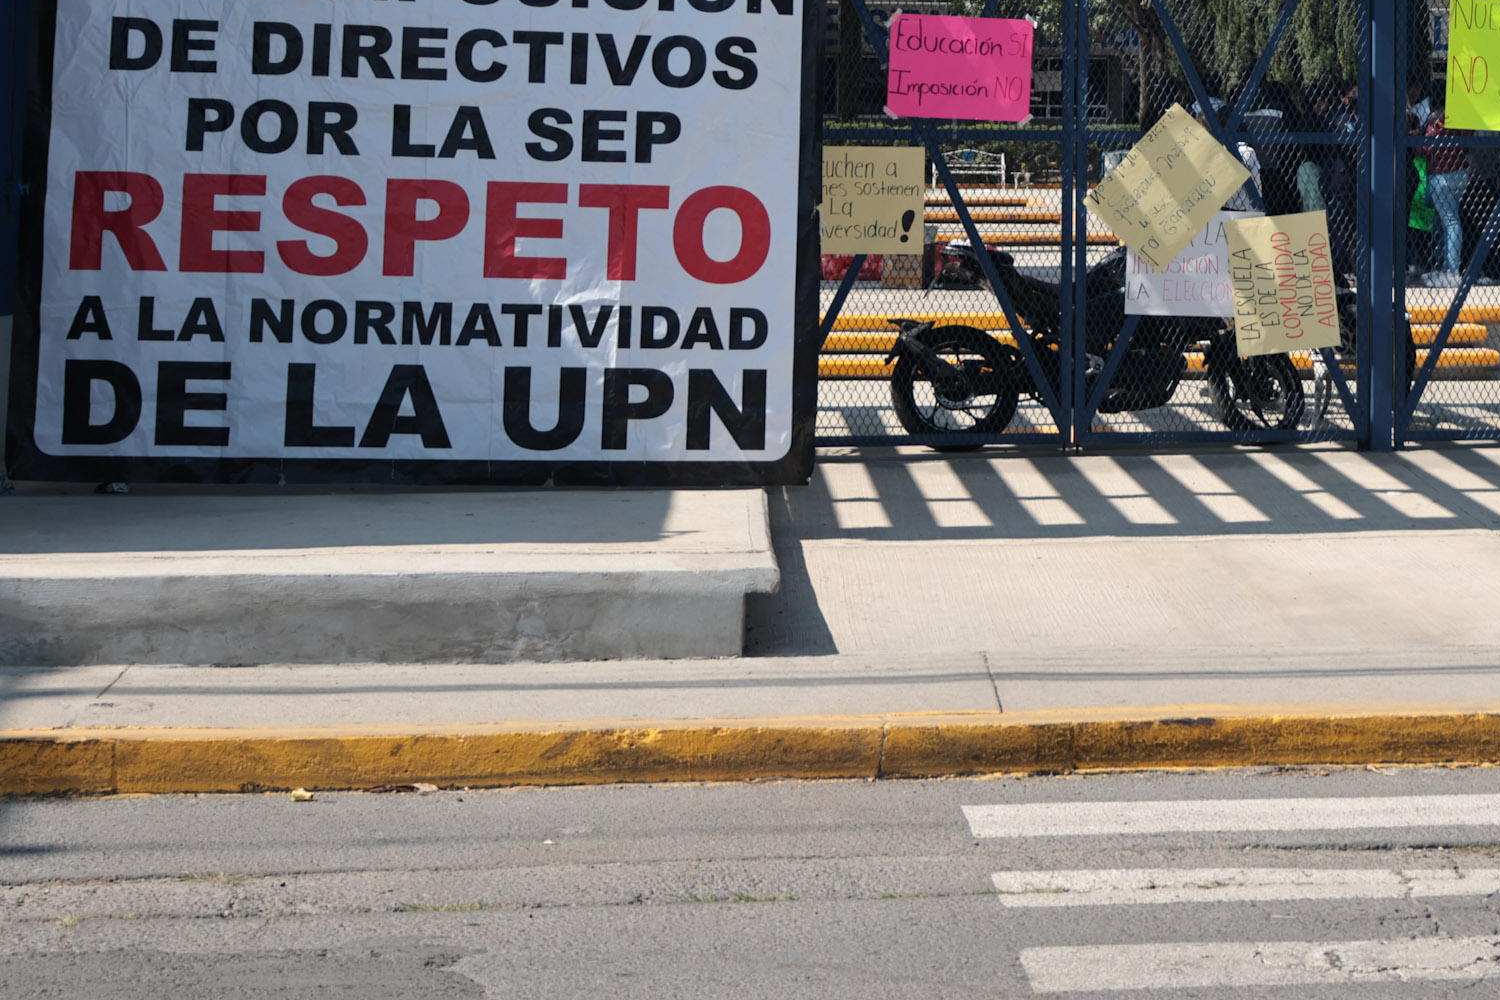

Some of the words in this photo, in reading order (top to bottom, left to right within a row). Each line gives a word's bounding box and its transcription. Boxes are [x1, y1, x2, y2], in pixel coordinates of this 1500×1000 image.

[895, 18, 1003, 57] Educación
[1008, 33, 1028, 59] SI
[109, 16, 219, 74] DE
[251, 20, 759, 91] DIRECTIVOS
[1451, 55, 1488, 95] NO
[889, 69, 988, 107] Imposición
[993, 77, 1023, 102] NO
[185, 97, 360, 157] POR
[392, 104, 497, 160] LA
[525, 107, 683, 164] SEP
[885, 162, 898, 178] a
[854, 181, 920, 197] sostienen
[829, 198, 853, 218] La
[69, 170, 772, 285] RESPETO
[1204, 221, 1229, 246] LA
[1132, 253, 1219, 275] IMOSICIÓN
[1293, 249, 1310, 266] LA
[1232, 248, 1257, 316] ESCUELA
[1254, 261, 1276, 280] LA
[1295, 272, 1313, 289] DE
[1308, 232, 1336, 328] AUTORIDAD
[1126, 281, 1150, 301] LA
[1257, 288, 1278, 305] DE
[1270, 231, 1304, 339] COMUNIDAD
[1297, 295, 1315, 316] NO
[67, 295, 113, 340] A
[138, 297, 225, 343] LA
[249, 299, 769, 351] NORMATIVIDAD
[1261, 311, 1281, 327] ES
[1240, 321, 1261, 341] LA
[60, 358, 231, 448] DE
[283, 362, 452, 449] LA
[502, 366, 768, 452] UPN
